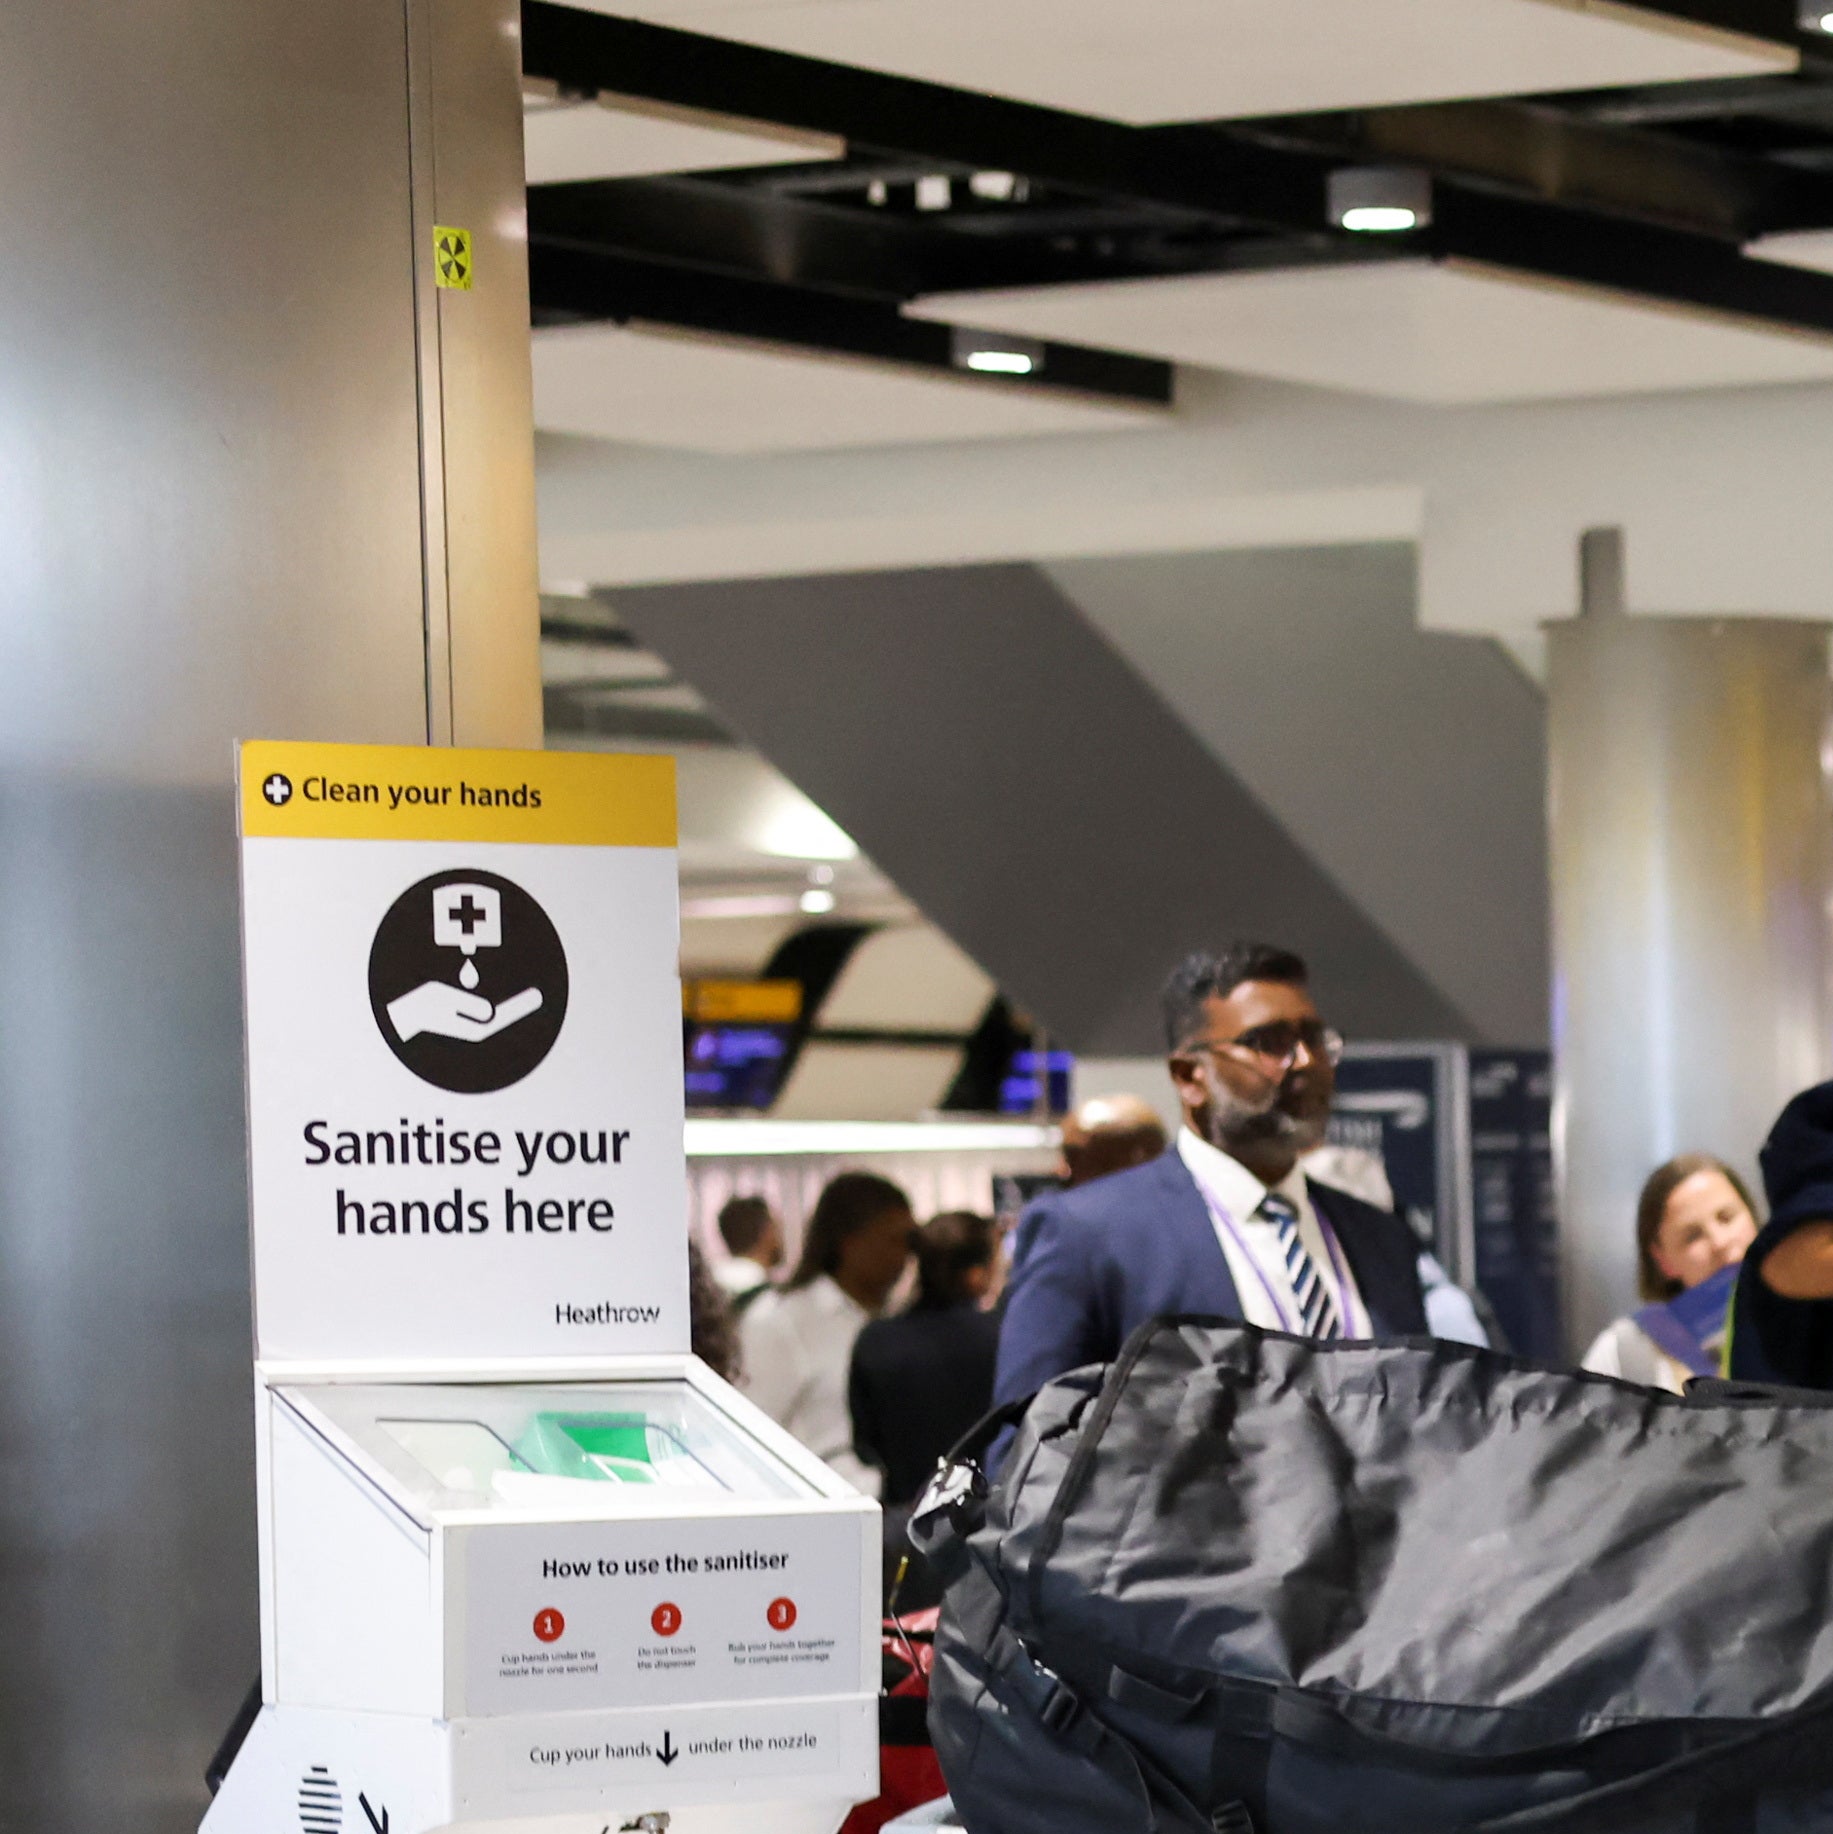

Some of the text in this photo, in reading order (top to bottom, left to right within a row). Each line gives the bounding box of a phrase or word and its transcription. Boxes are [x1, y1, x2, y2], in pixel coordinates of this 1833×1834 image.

[302, 776, 542, 810] Clean your hands
[303, 1118, 630, 1176] Sanitise your
[335, 1188, 615, 1236] hands here
[554, 1301, 661, 1326] Heathrow
[543, 1550, 790, 1579] How to use the sanitiser
[544, 1616, 554, 1633] 1
[661, 1610, 672, 1629] 2
[769, 1639, 796, 1651] hands
[501, 1649, 597, 1667] Cup hands under the
[531, 1664, 545, 1676] for
[567, 1662, 599, 1675] second
[733, 1654, 747, 1666] for
[530, 1732, 818, 1765] Cup your hands under the nozzle
